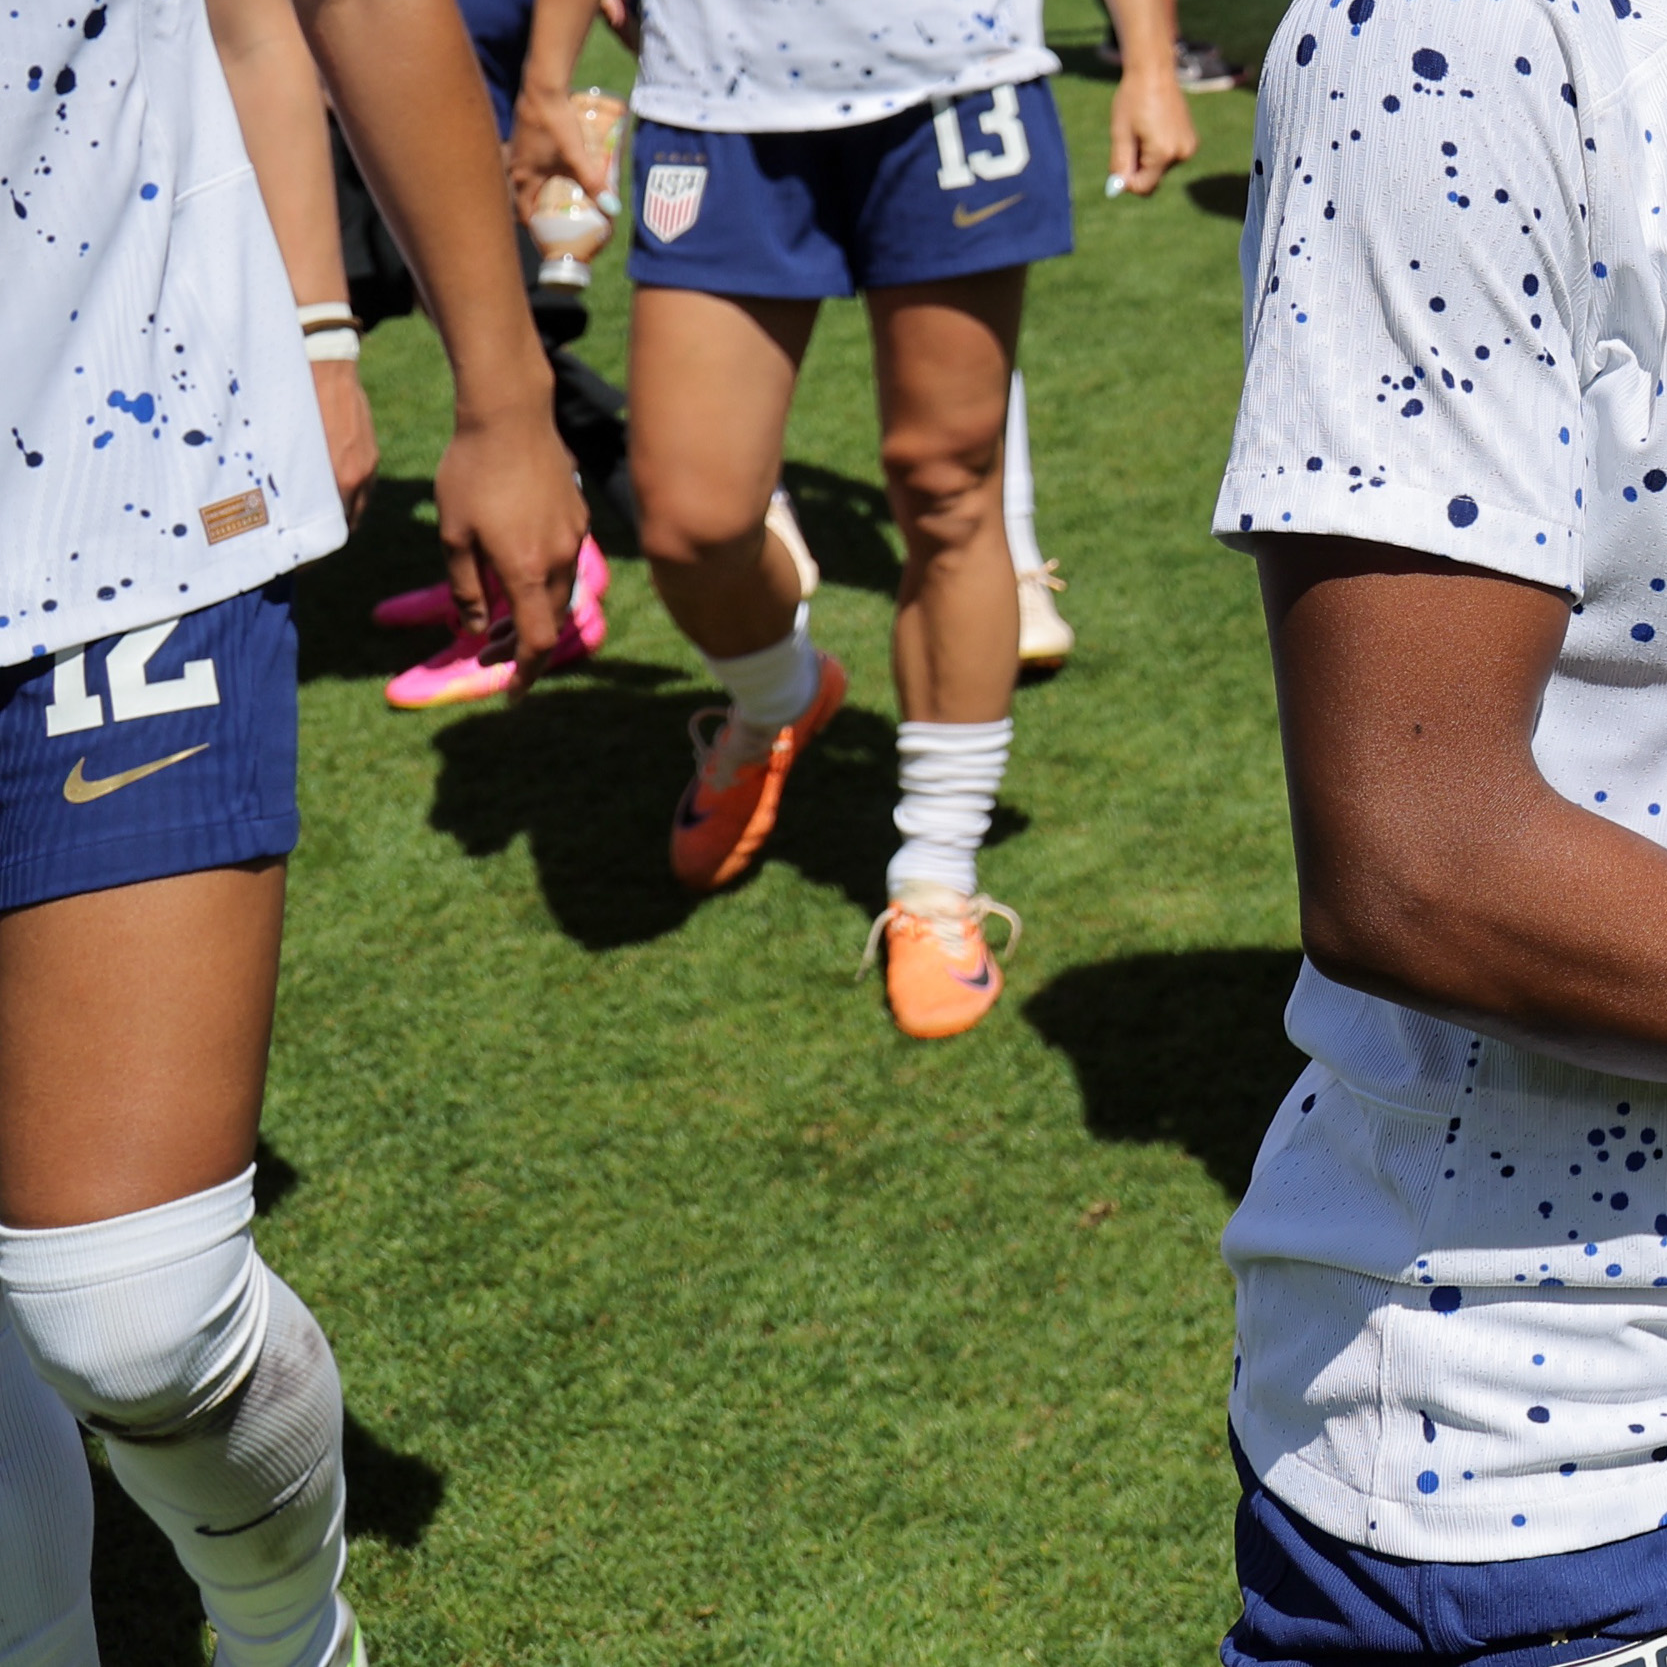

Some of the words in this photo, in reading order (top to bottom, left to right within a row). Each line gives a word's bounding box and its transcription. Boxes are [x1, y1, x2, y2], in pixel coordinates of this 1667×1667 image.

[650, 171, 697, 197] USA
[931, 84, 1031, 190] 13
[45, 620, 220, 738] 12
